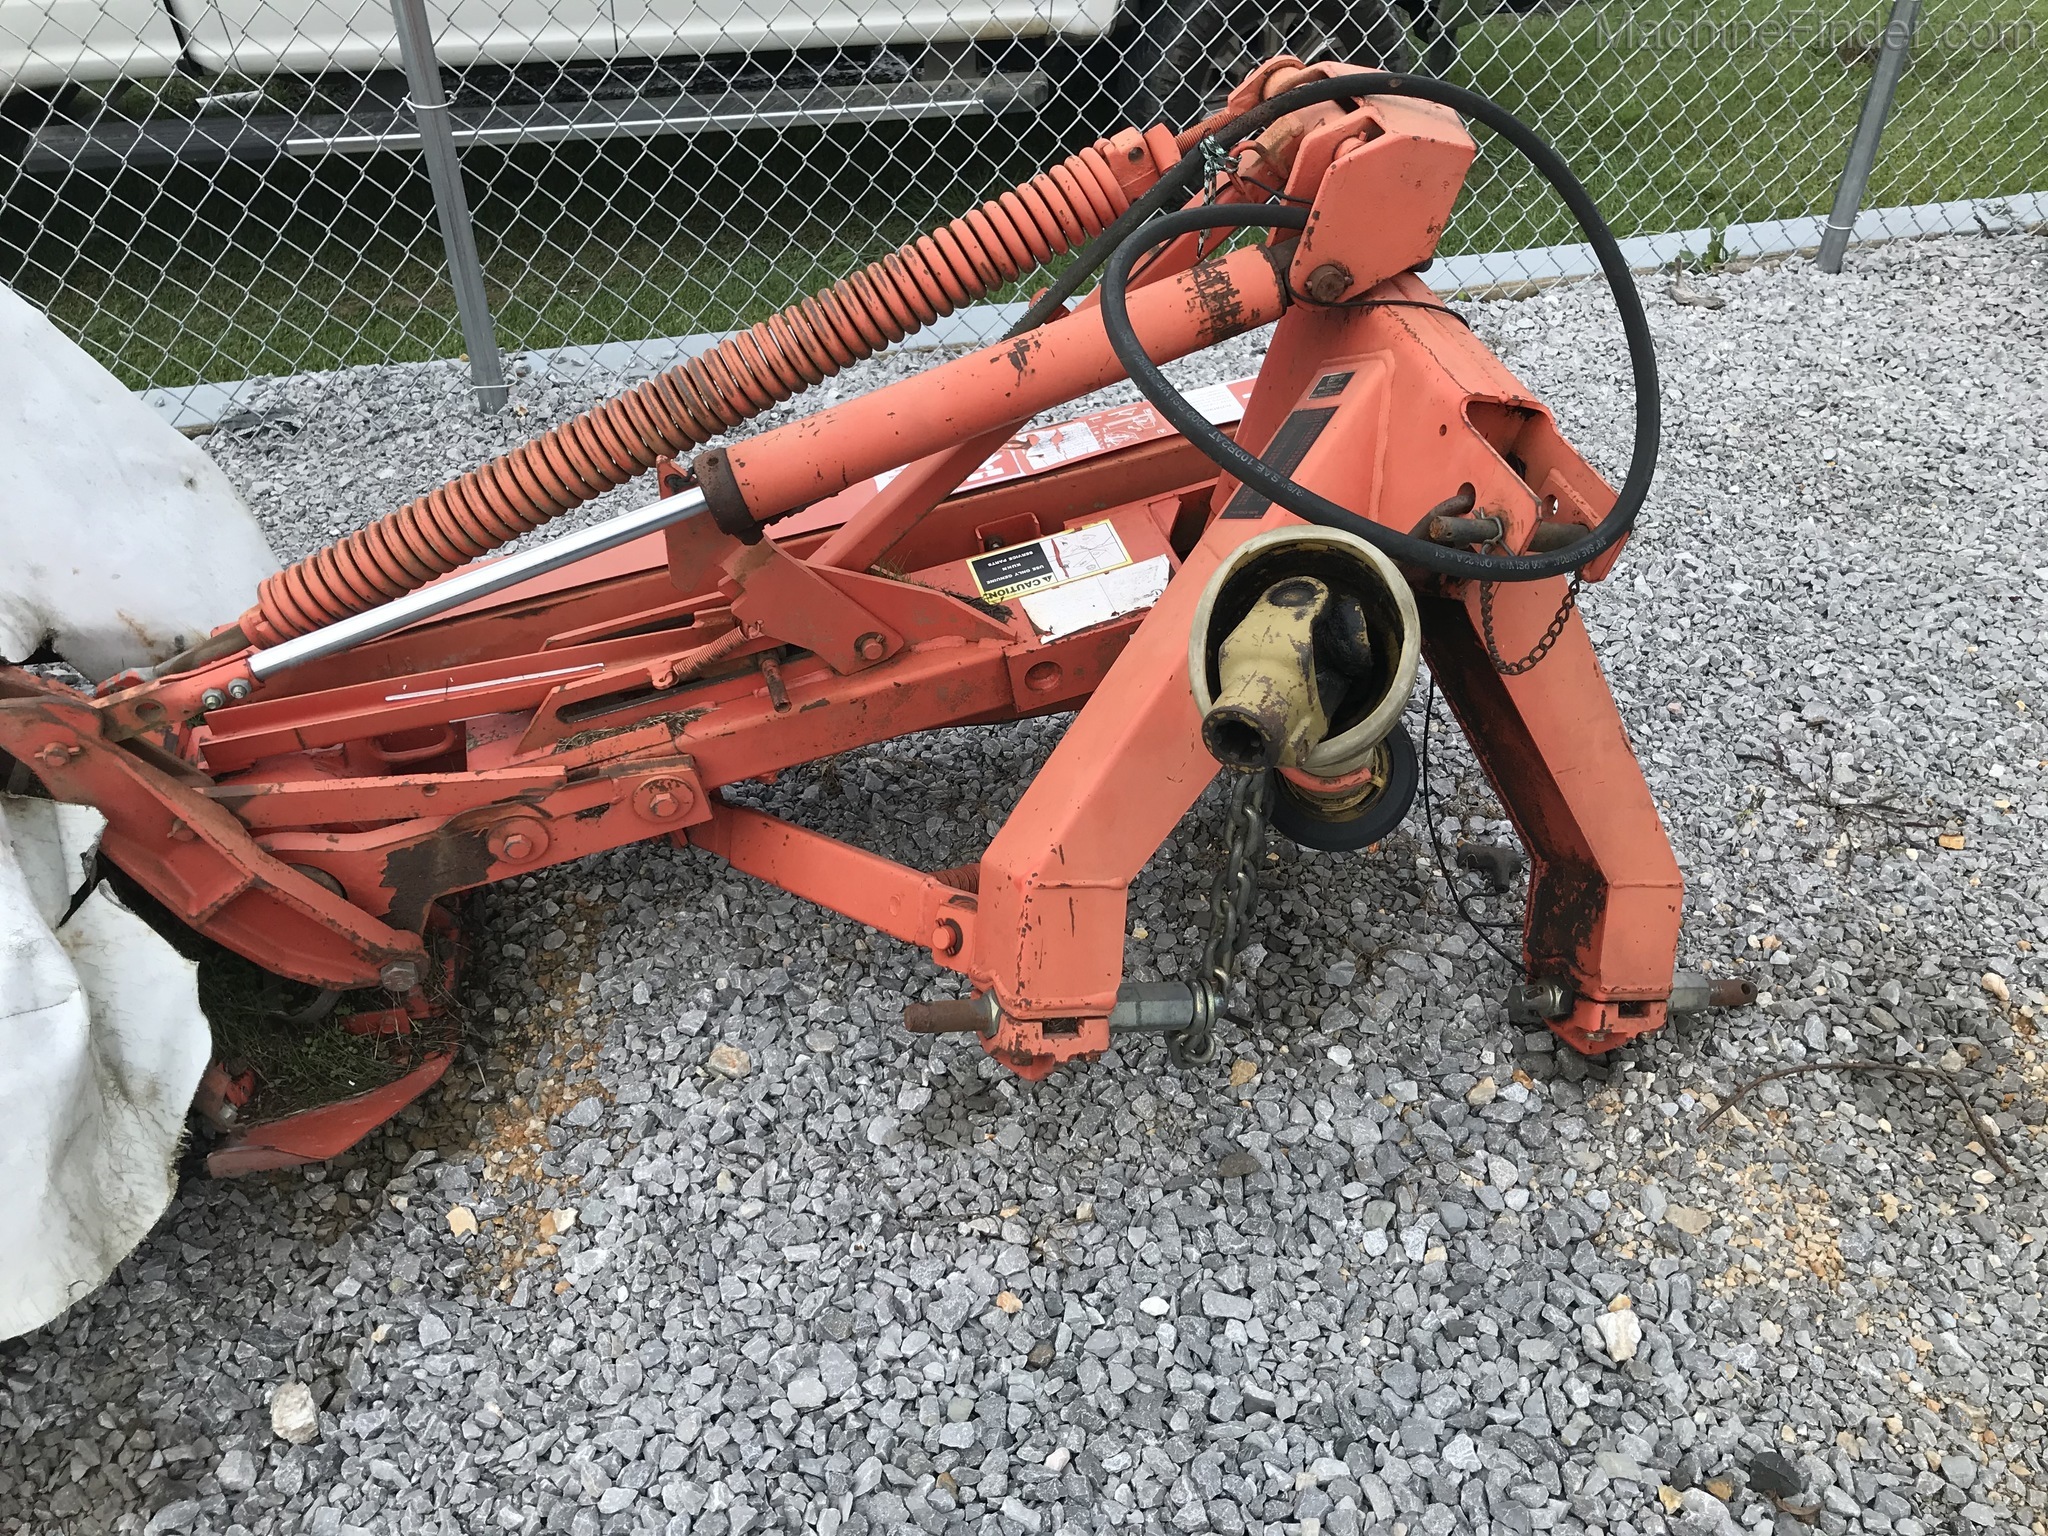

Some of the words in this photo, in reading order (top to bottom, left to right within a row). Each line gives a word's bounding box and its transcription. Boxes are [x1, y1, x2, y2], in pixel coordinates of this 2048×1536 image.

[1208, 430, 1254, 466] 100R2AT
[1256, 463, 1281, 483] SAE
[1008, 550, 1034, 560] SERVICE
[987, 558, 1008, 567] PARTS
[1002, 562, 1022, 571] KUHN
[1014, 569, 1031, 577] ONLY
[986, 574, 1013, 584] GENUINE
